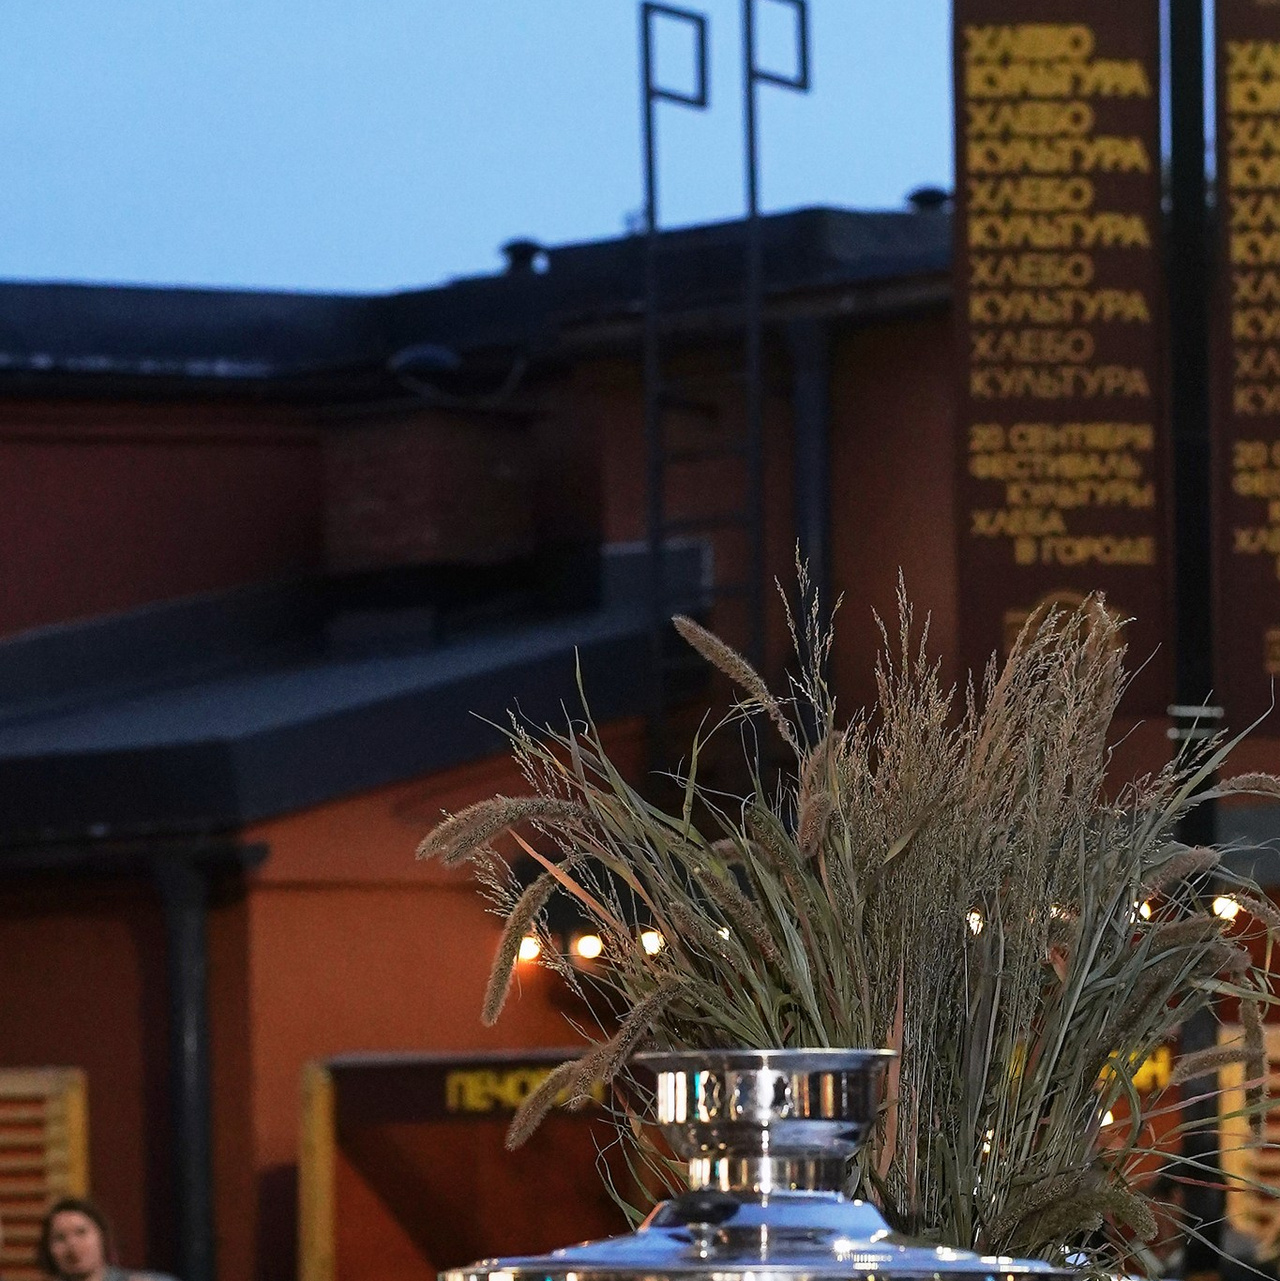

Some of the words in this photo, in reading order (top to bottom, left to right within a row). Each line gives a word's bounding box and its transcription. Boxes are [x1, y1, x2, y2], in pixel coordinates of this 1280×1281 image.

[971, 251, 1093, 288] ХЛЕБО
[973, 326, 1095, 363] ХЛЕБО
[970, 363, 1149, 400] КУЛЬТУРА
[1042, 537, 1154, 565] ГОРОДЕ
